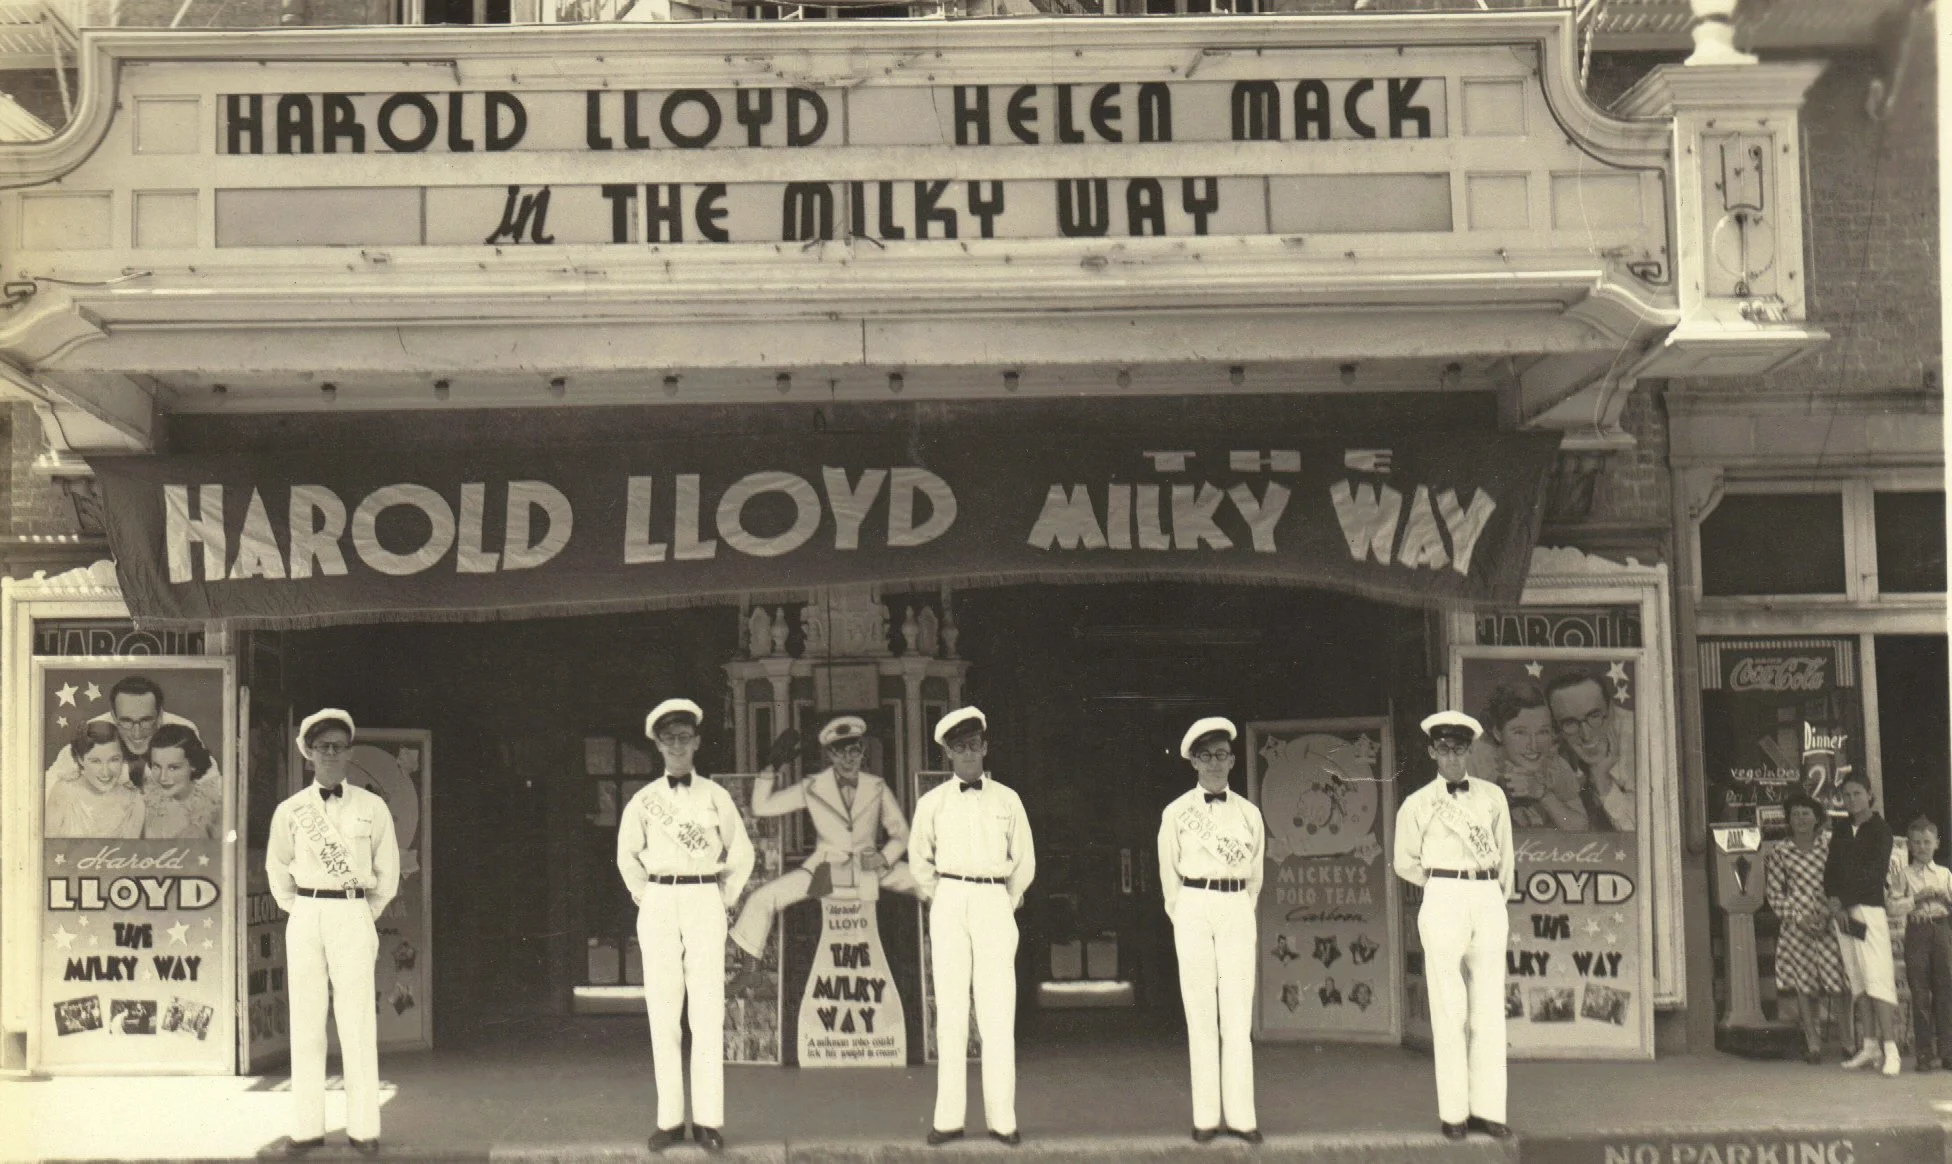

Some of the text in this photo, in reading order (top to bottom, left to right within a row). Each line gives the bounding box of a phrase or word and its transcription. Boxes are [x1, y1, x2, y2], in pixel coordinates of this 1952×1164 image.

[226, 78, 1431, 154] HAROLD LLOYD HELEN MACK
[485, 177, 1219, 245] in THE MILKY WAY
[163, 466, 1497, 585] HAROLD LLOYD MILKY WAY
[1804, 721, 1848, 750] Dinner
[77, 845, 188, 870] Harold
[1277, 865, 1368, 884] MICKEYS
[1507, 869, 1636, 905] LOYD
[47, 876, 221, 912] LLOYD
[1276, 887, 1373, 905] POLO TEAM
[113, 922, 154, 951] THE
[829, 917, 869, 931] LLOYD
[1531, 913, 1572, 941] THE
[64, 955, 203, 982] MILKY WAY
[830, 942, 871, 969] THE
[1505, 949, 1623, 978] LKY WAY
[812, 975, 886, 1003] MILKY
[816, 1005, 875, 1034] WAY
